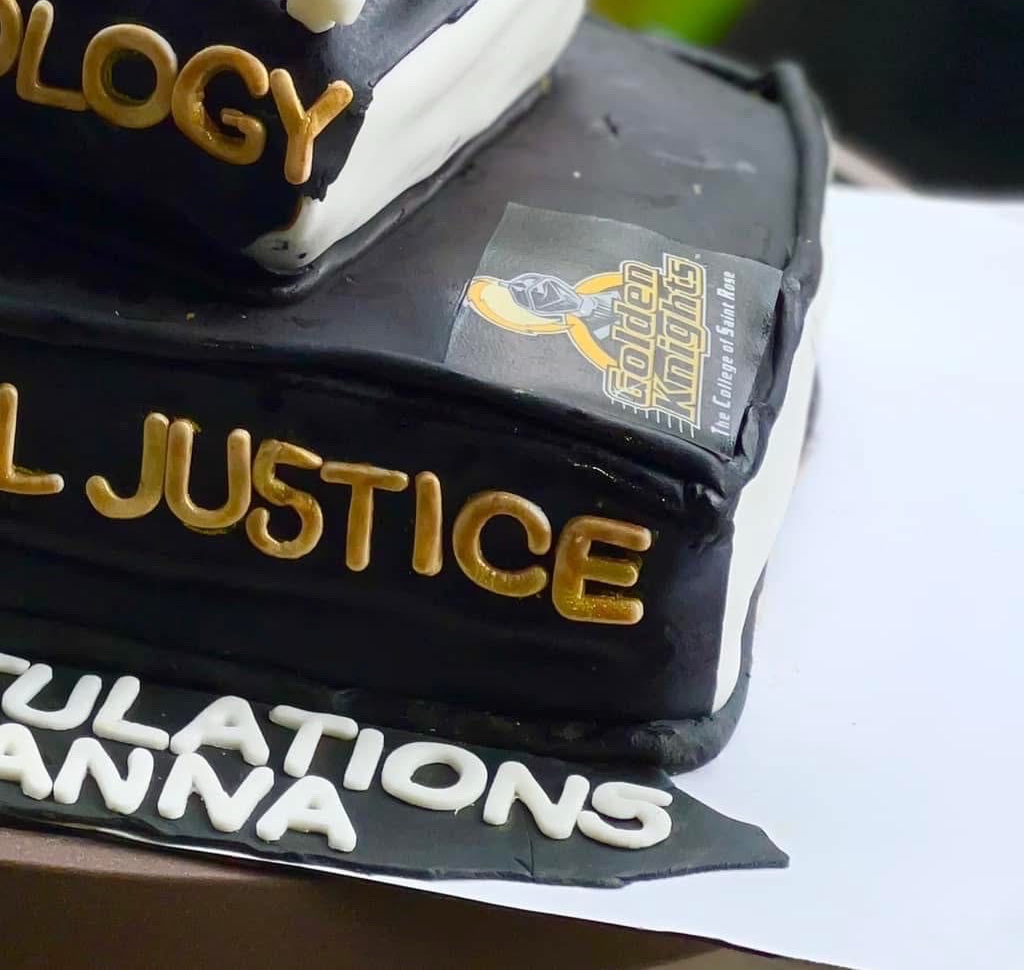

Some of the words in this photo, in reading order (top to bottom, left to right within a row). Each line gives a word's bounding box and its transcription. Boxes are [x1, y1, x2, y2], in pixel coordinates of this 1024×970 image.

[717, 271, 736, 301] Rose
[604, 261, 658, 409] Golden
[655, 254, 711, 428] Knights
[716, 303, 736, 337] Saint
[720, 339, 735, 355] of
[712, 355, 736, 407] College
[711, 413, 730, 436] The
[87, 413, 652, 625] JUSTICE
